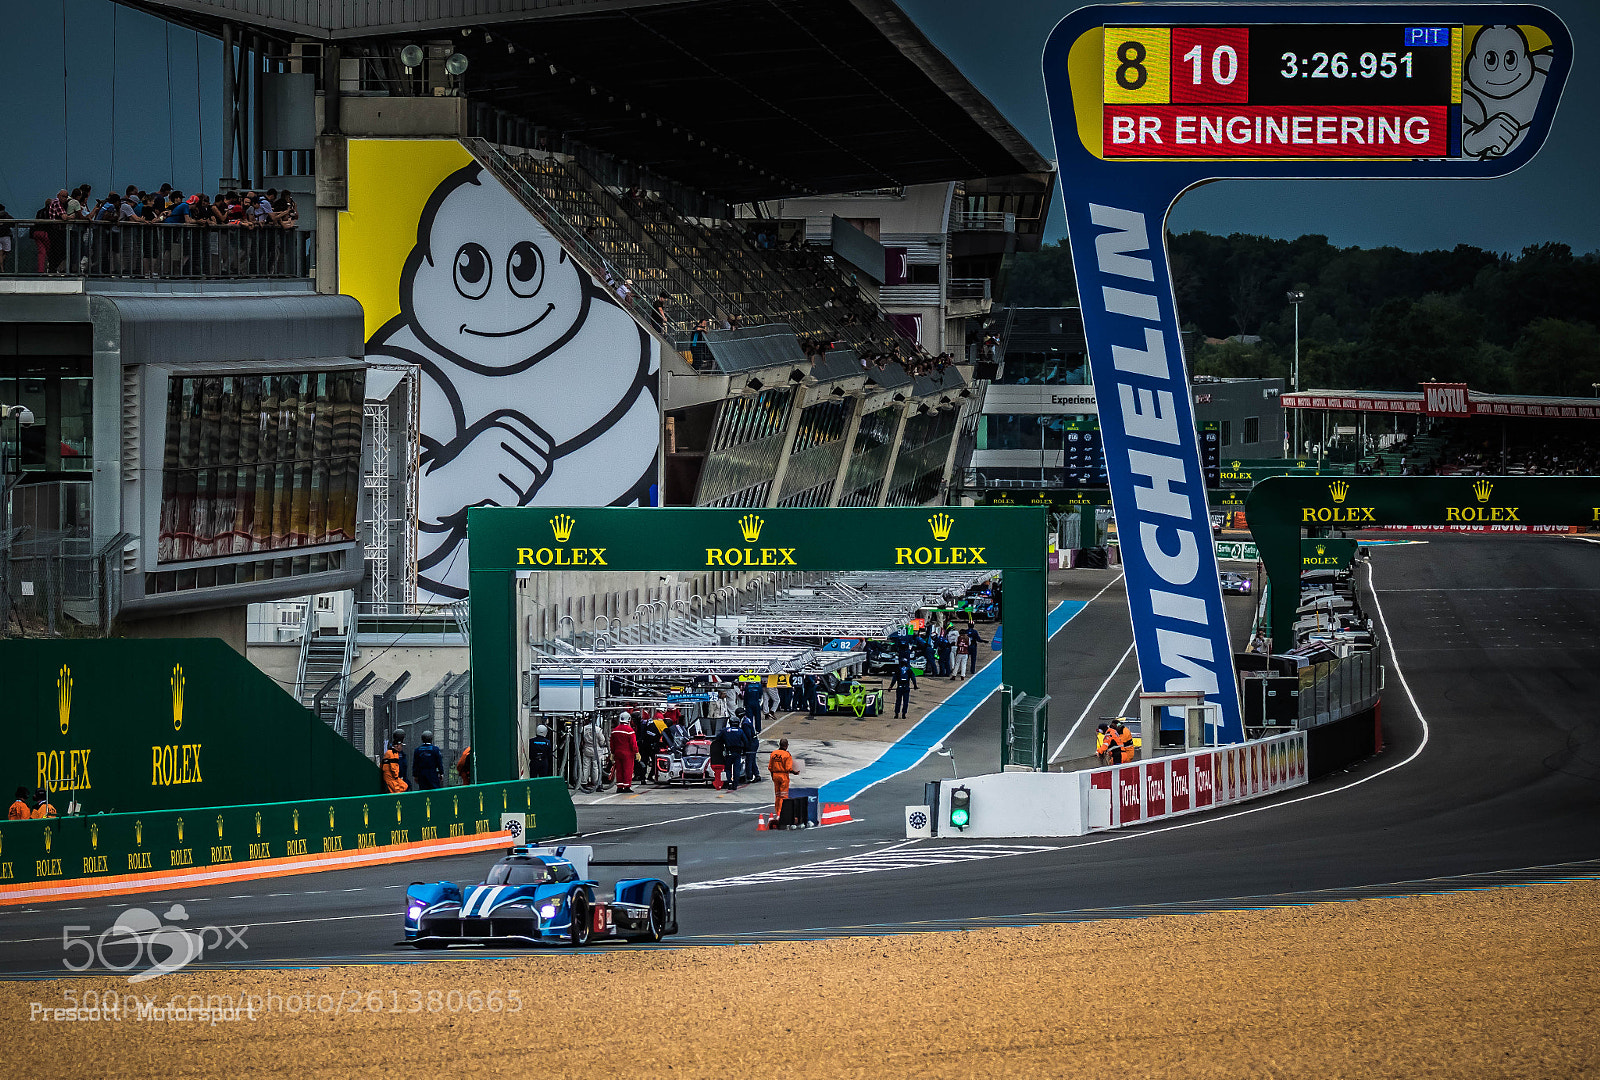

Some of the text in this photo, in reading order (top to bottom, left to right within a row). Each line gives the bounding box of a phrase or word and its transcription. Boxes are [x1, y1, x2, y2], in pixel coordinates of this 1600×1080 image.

[1411, 28, 1441, 44] PIT
[1115, 41, 1415, 91] 8 10 3:26.951
[1112, 116, 1431, 145] BR ENGINEERING
[1426, 388, 1468, 413] MOTUL
[1088, 202, 1225, 728] MICHELIN
[1220, 472, 1252, 480] ROLEX
[1301, 507, 1520, 522] ROLEX ROLEX
[516, 546, 988, 566] ROLEX ROLEX ROLEX
[1303, 557, 1338, 565] ROLEX
[840, 641, 851, 650] 82
[792, 676, 803, 686] 29
[36, 743, 203, 793] ROLEX ROLEX
[1120, 780, 1140, 807] TOTAL
[1147, 775, 1165, 802] TOTAL
[1172, 770, 1189, 797] TOTAL
[1195, 766, 1212, 792] TOTAL
[36, 858, 63, 877] ROLEX
[83, 855, 109, 874] ROLEX
[128, 852, 153, 870] ROLEX
[170, 848, 193, 867] ROLEX
[210, 845, 233, 863] ROLEX
[249, 842, 271, 860] ROLEX
[286, 838, 308, 856] ROLEX
[323, 835, 343, 853] ROLEX
[357, 832, 377, 849] ROLEX
[390, 829, 409, 846] ROLEX
